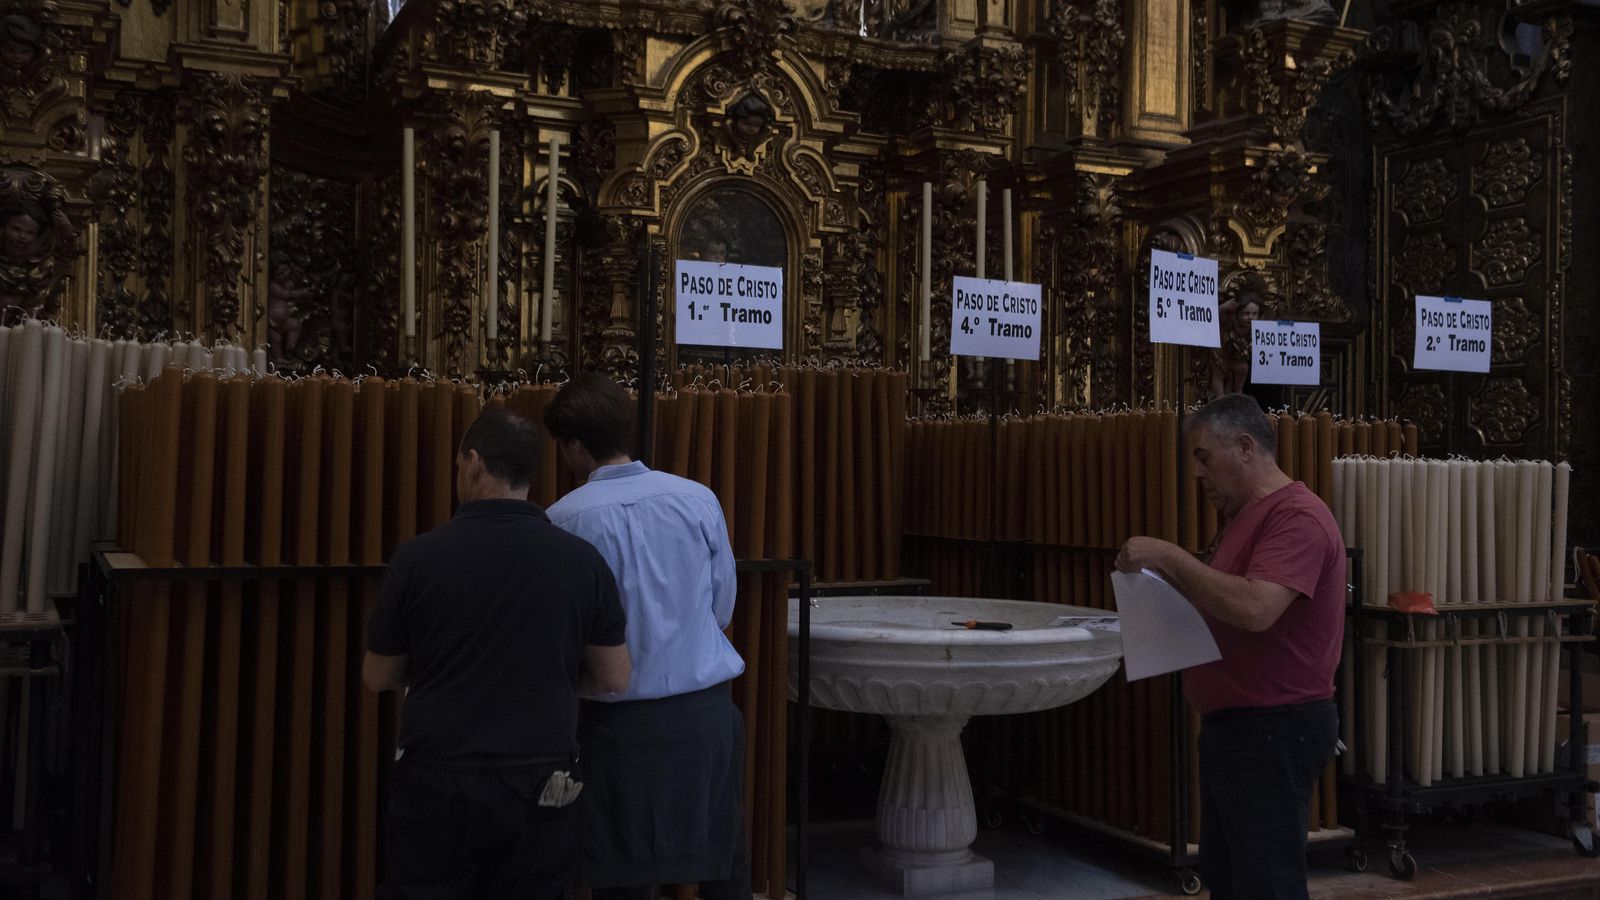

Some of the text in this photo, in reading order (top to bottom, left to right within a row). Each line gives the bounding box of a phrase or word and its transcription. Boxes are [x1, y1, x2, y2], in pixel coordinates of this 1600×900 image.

[681, 272, 778, 299] PASO DE CRISTO
[1153, 265, 1215, 296] PASO DE CRISTO
[957, 288, 1038, 315] PASO DE CRISTO
[1177, 299, 1212, 323] Tramo
[720, 302, 772, 324] Tramo
[1421, 308, 1490, 330] PASO DE CRISTO
[988, 317, 1032, 339] Tramo
[1255, 329, 1317, 348] PASO DE CRISTO
[1448, 334, 1486, 353] Tramo
[1280, 351, 1314, 367] Tramo
